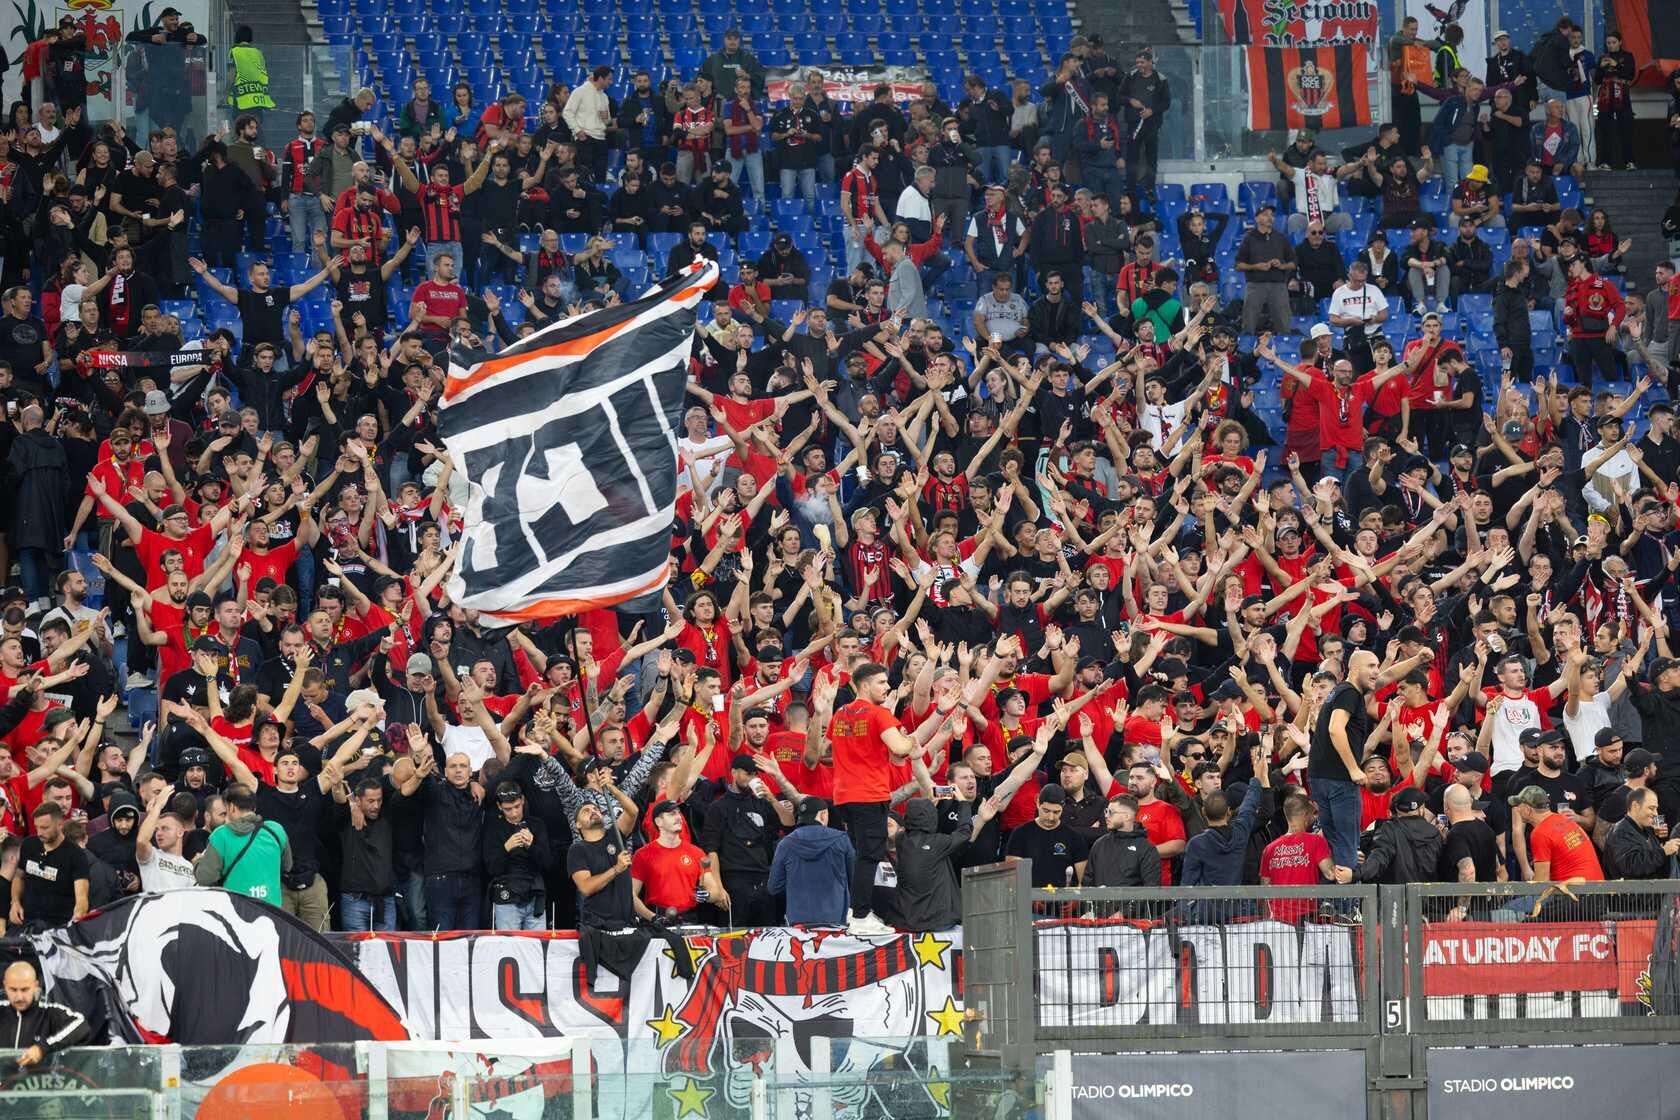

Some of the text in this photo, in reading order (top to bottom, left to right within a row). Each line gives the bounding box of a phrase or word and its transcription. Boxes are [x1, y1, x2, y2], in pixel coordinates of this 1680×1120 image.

[98, 352, 203, 367] NISSA EUROPA
[249, 885, 268, 898] 115
[1410, 934, 1610, 967] ATURDAY FC
[1388, 1002, 1400, 1027] 5
[1070, 1083, 1193, 1099] TADIO OLIMPICO
[1443, 1076, 1574, 1093] STADIO OLIMPICO
